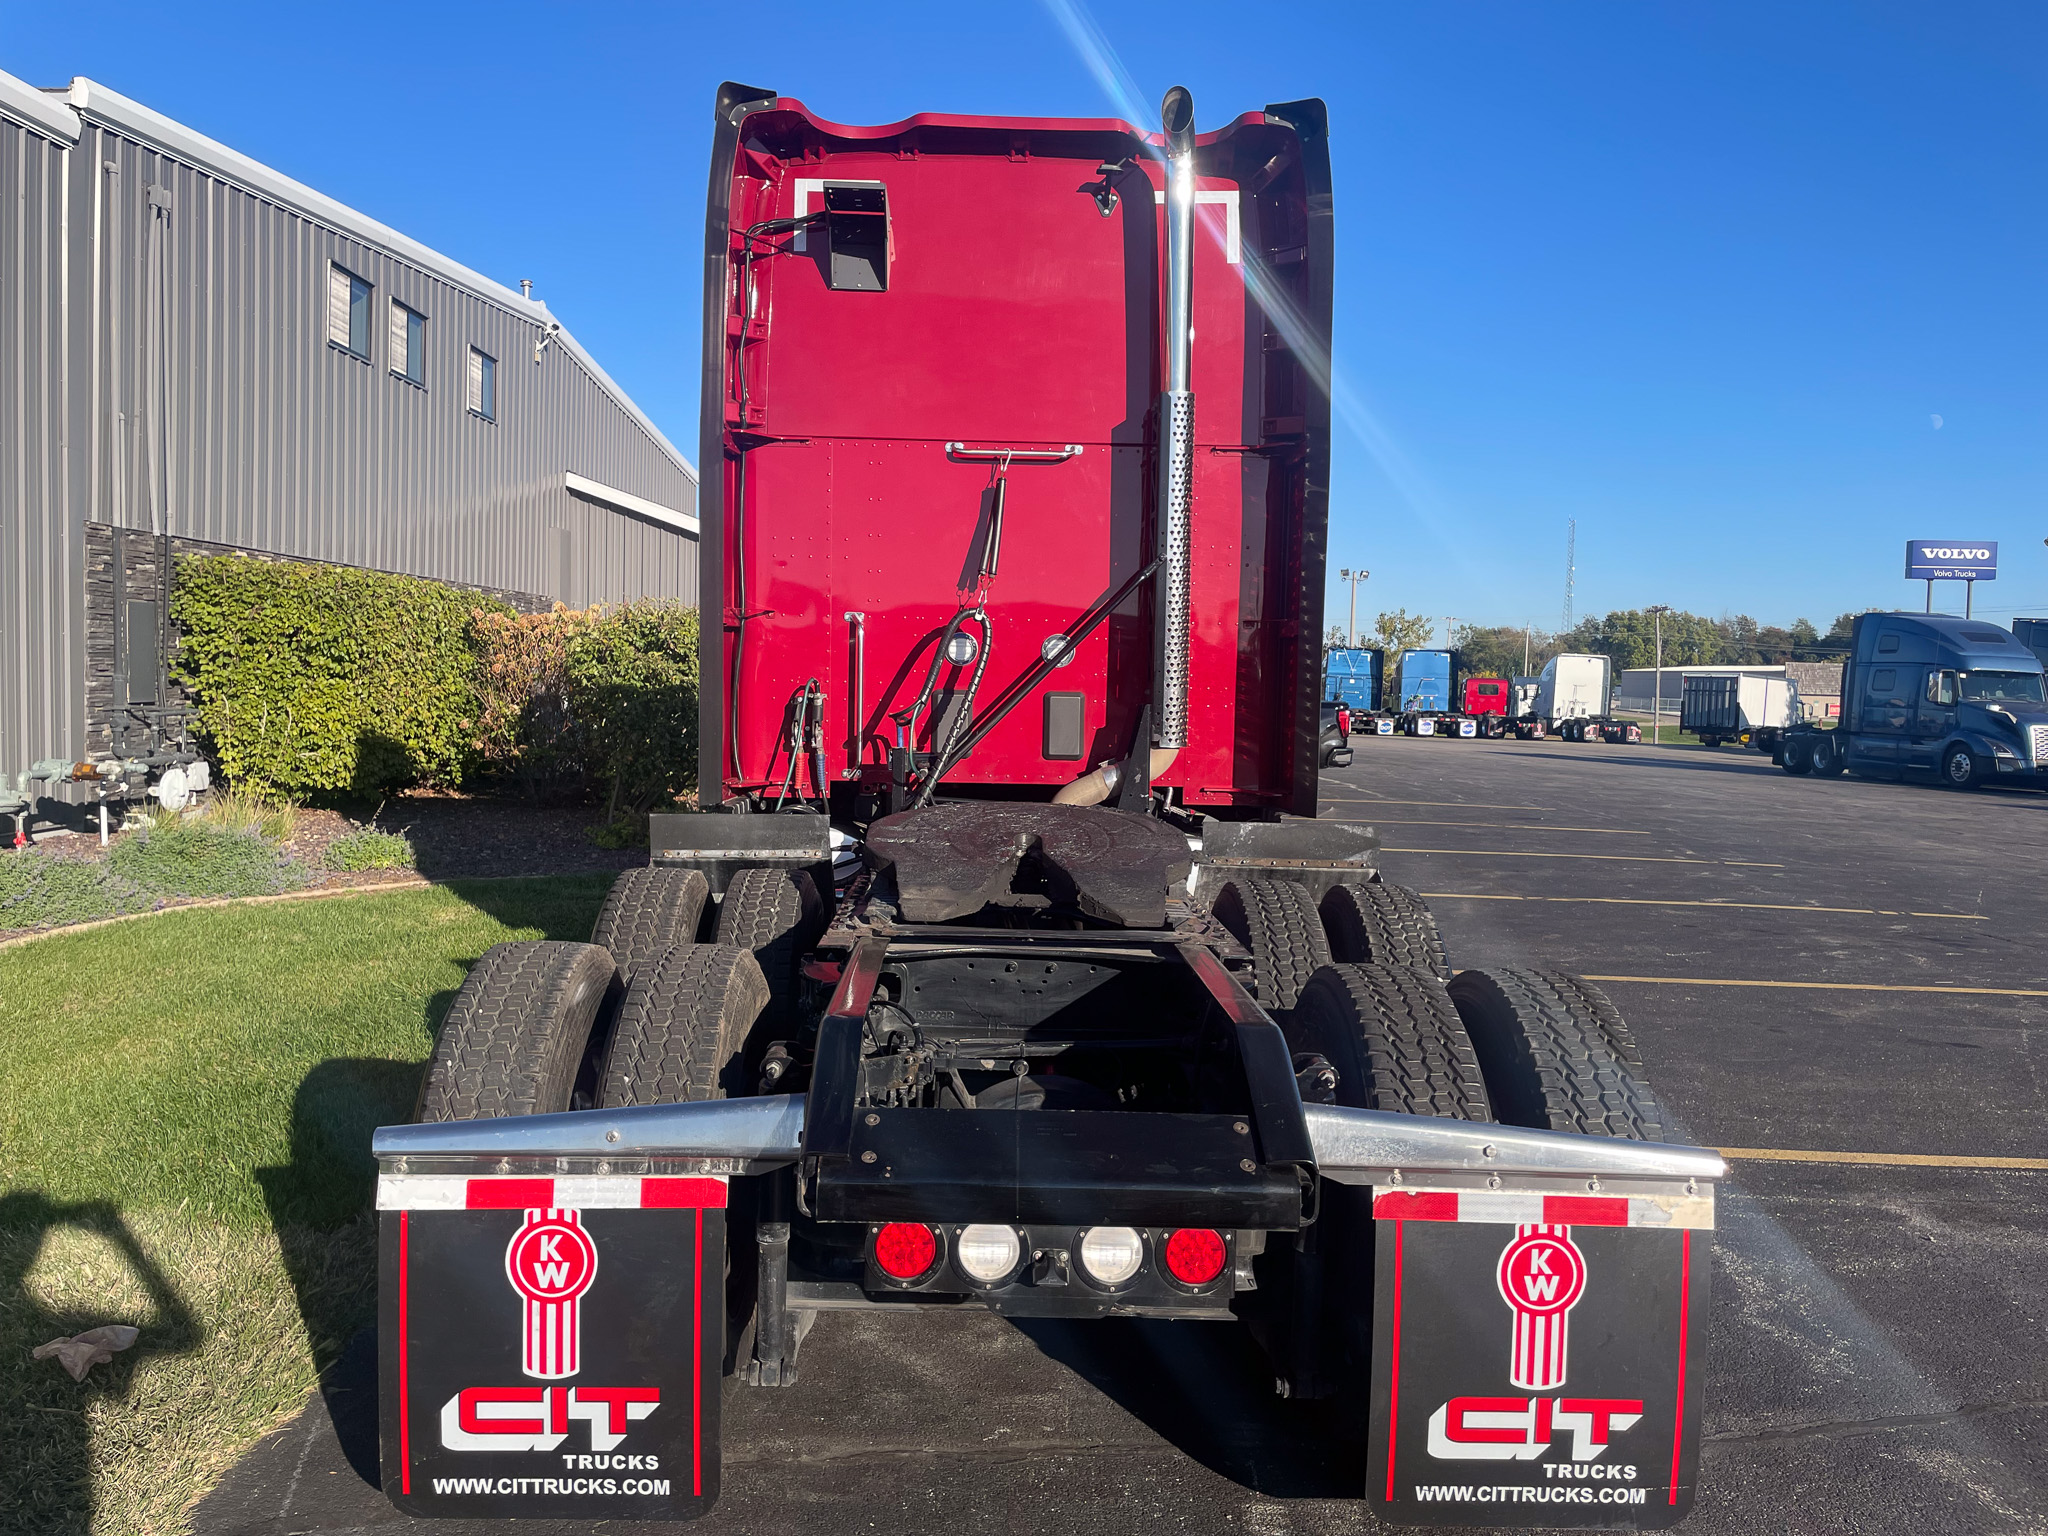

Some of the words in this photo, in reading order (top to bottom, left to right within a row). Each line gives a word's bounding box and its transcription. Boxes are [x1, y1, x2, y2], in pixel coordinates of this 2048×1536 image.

[1921, 548, 1990, 560] VOLVO
[1933, 569, 1952, 577] Volvo
[1954, 569, 1976, 577] Trucks
[915, 1010, 955, 1020] PACCAR
[540, 1234, 563, 1261] K
[1530, 1248, 1553, 1274] K
[533, 1262, 570, 1288] W
[1523, 1275, 1560, 1301] W
[441, 1386, 660, 1451] CIT
[1427, 1396, 1643, 1461] CIT
[562, 1454, 659, 1470] TRUCKS
[1543, 1463, 1637, 1480] TRUCKS
[433, 1478, 671, 1496] WWW.CITTRUCKS.COM
[1415, 1485, 1646, 1504] WWW.CITTRUCKS.COM
